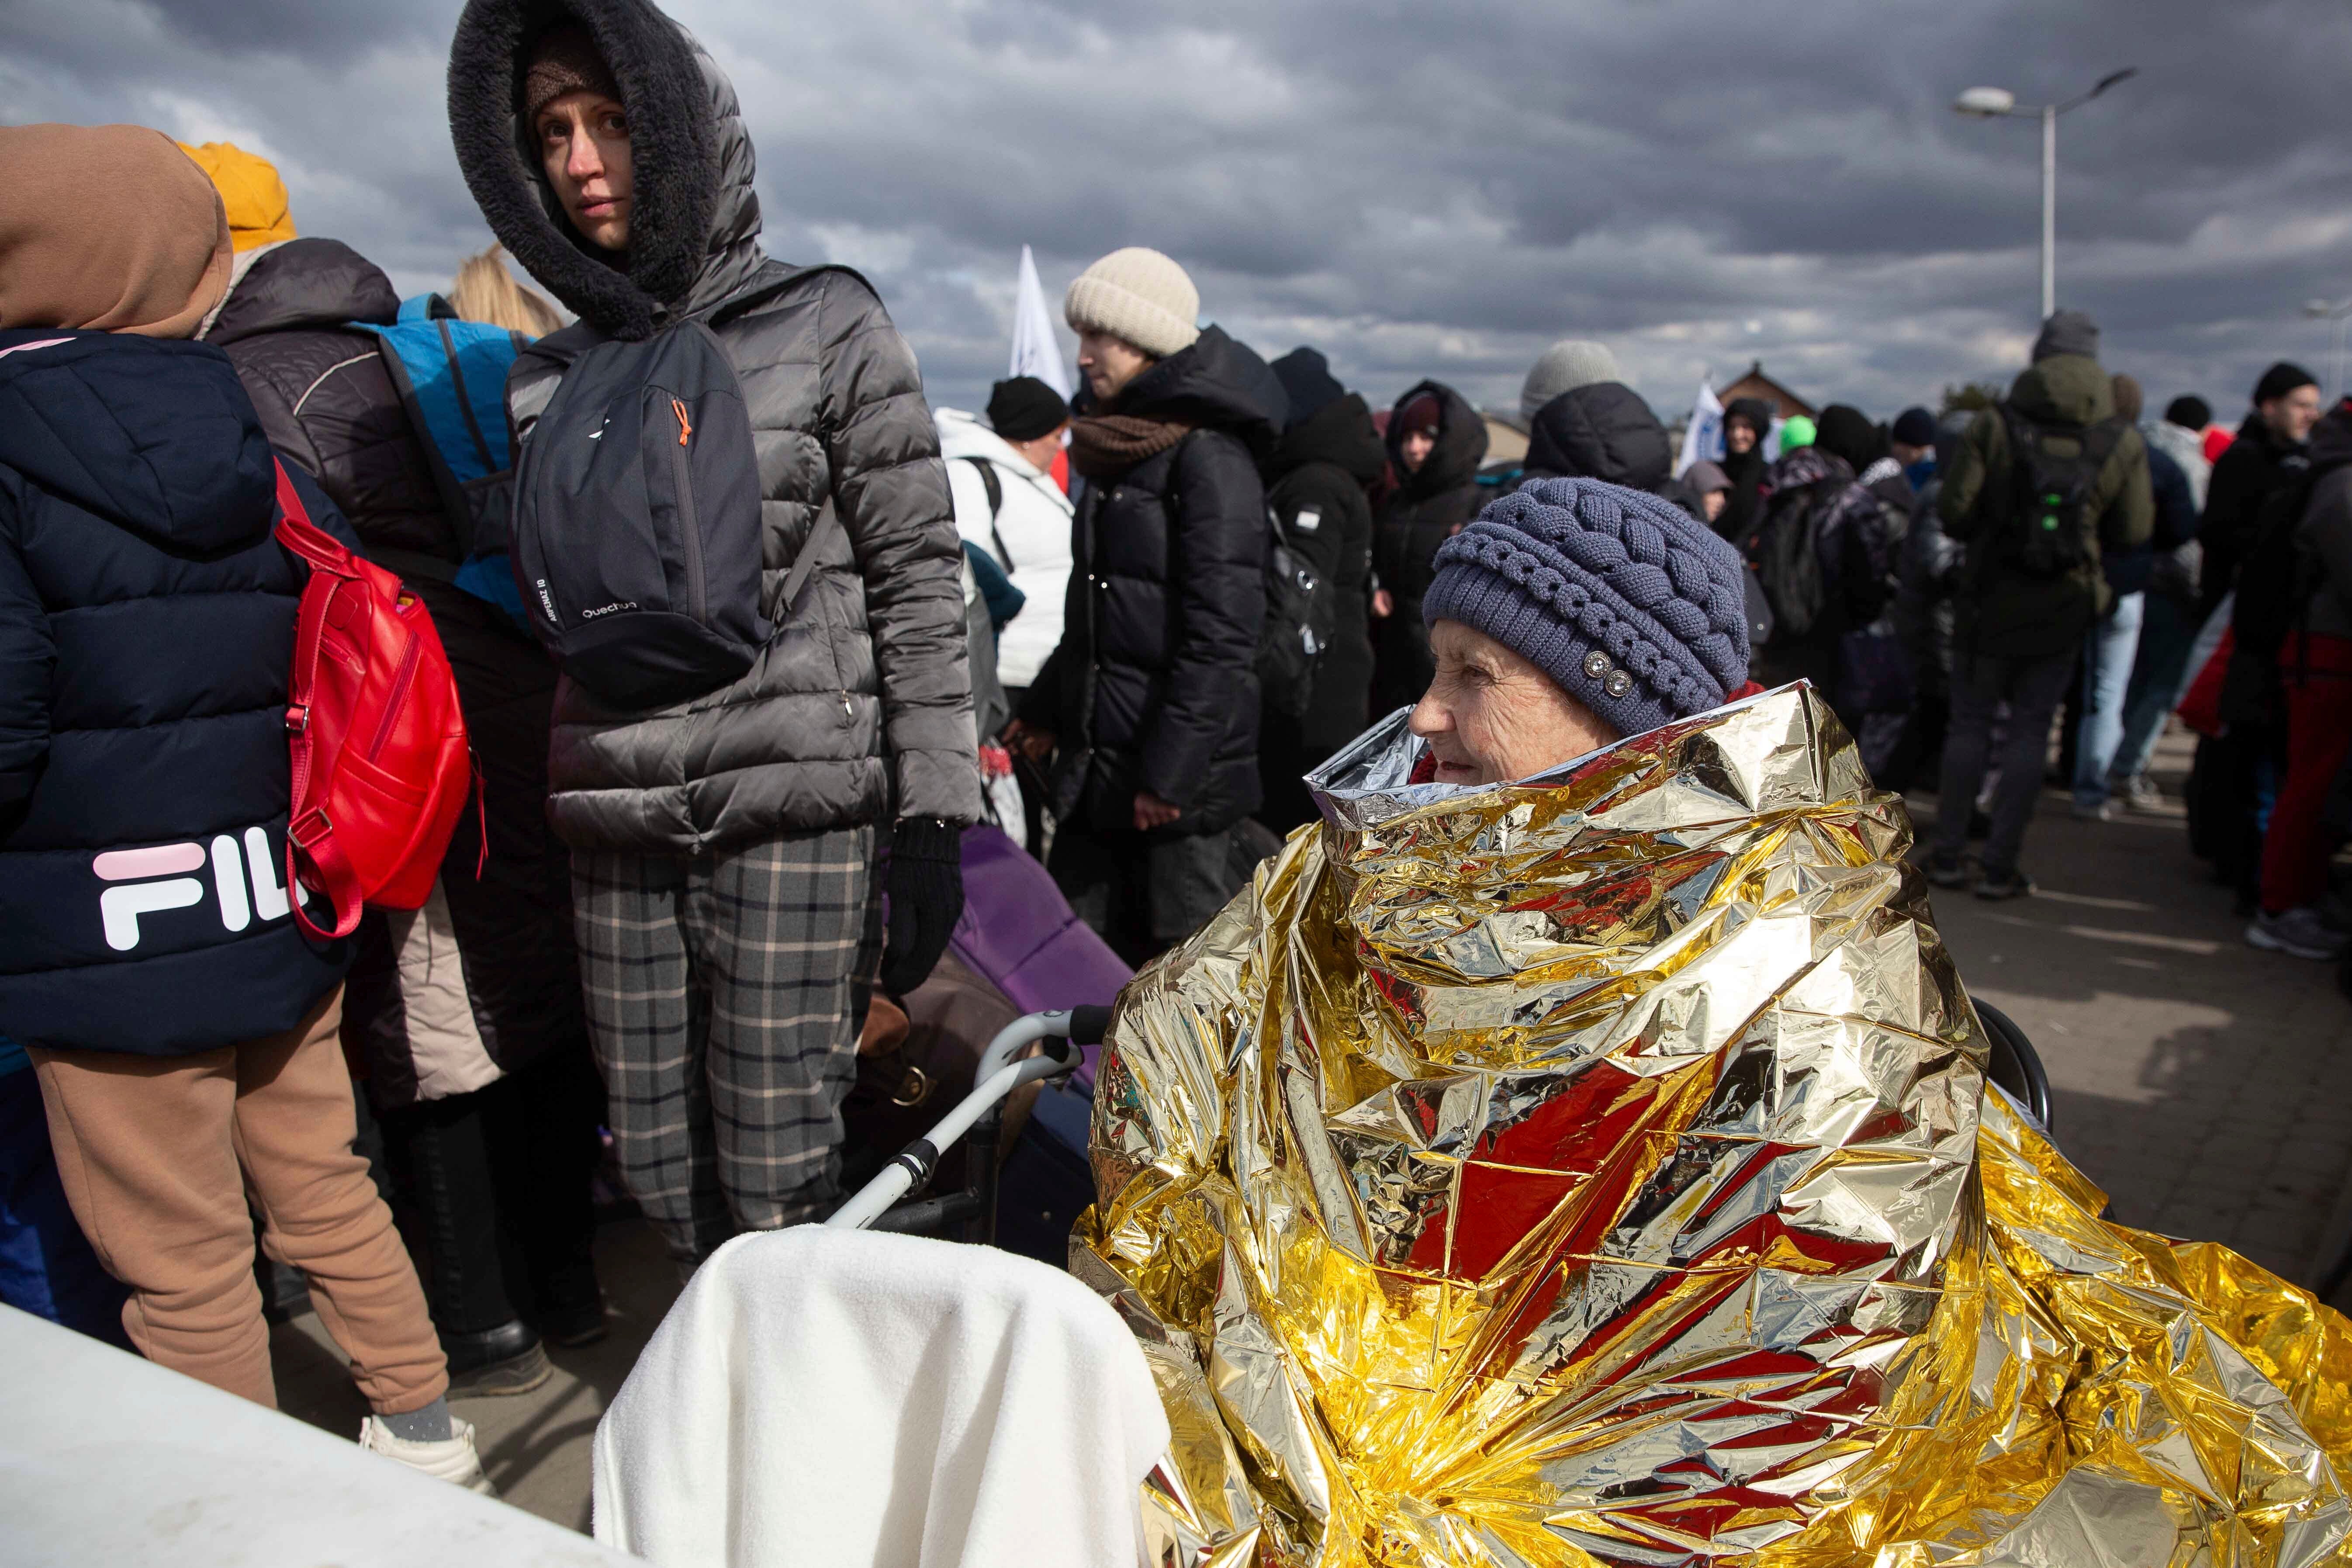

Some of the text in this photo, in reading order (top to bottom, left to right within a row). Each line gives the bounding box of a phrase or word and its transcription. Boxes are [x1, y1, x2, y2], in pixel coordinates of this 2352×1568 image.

[537, 579, 557, 621] ARPENAZ 10
[583, 602, 637, 619] Quechua
